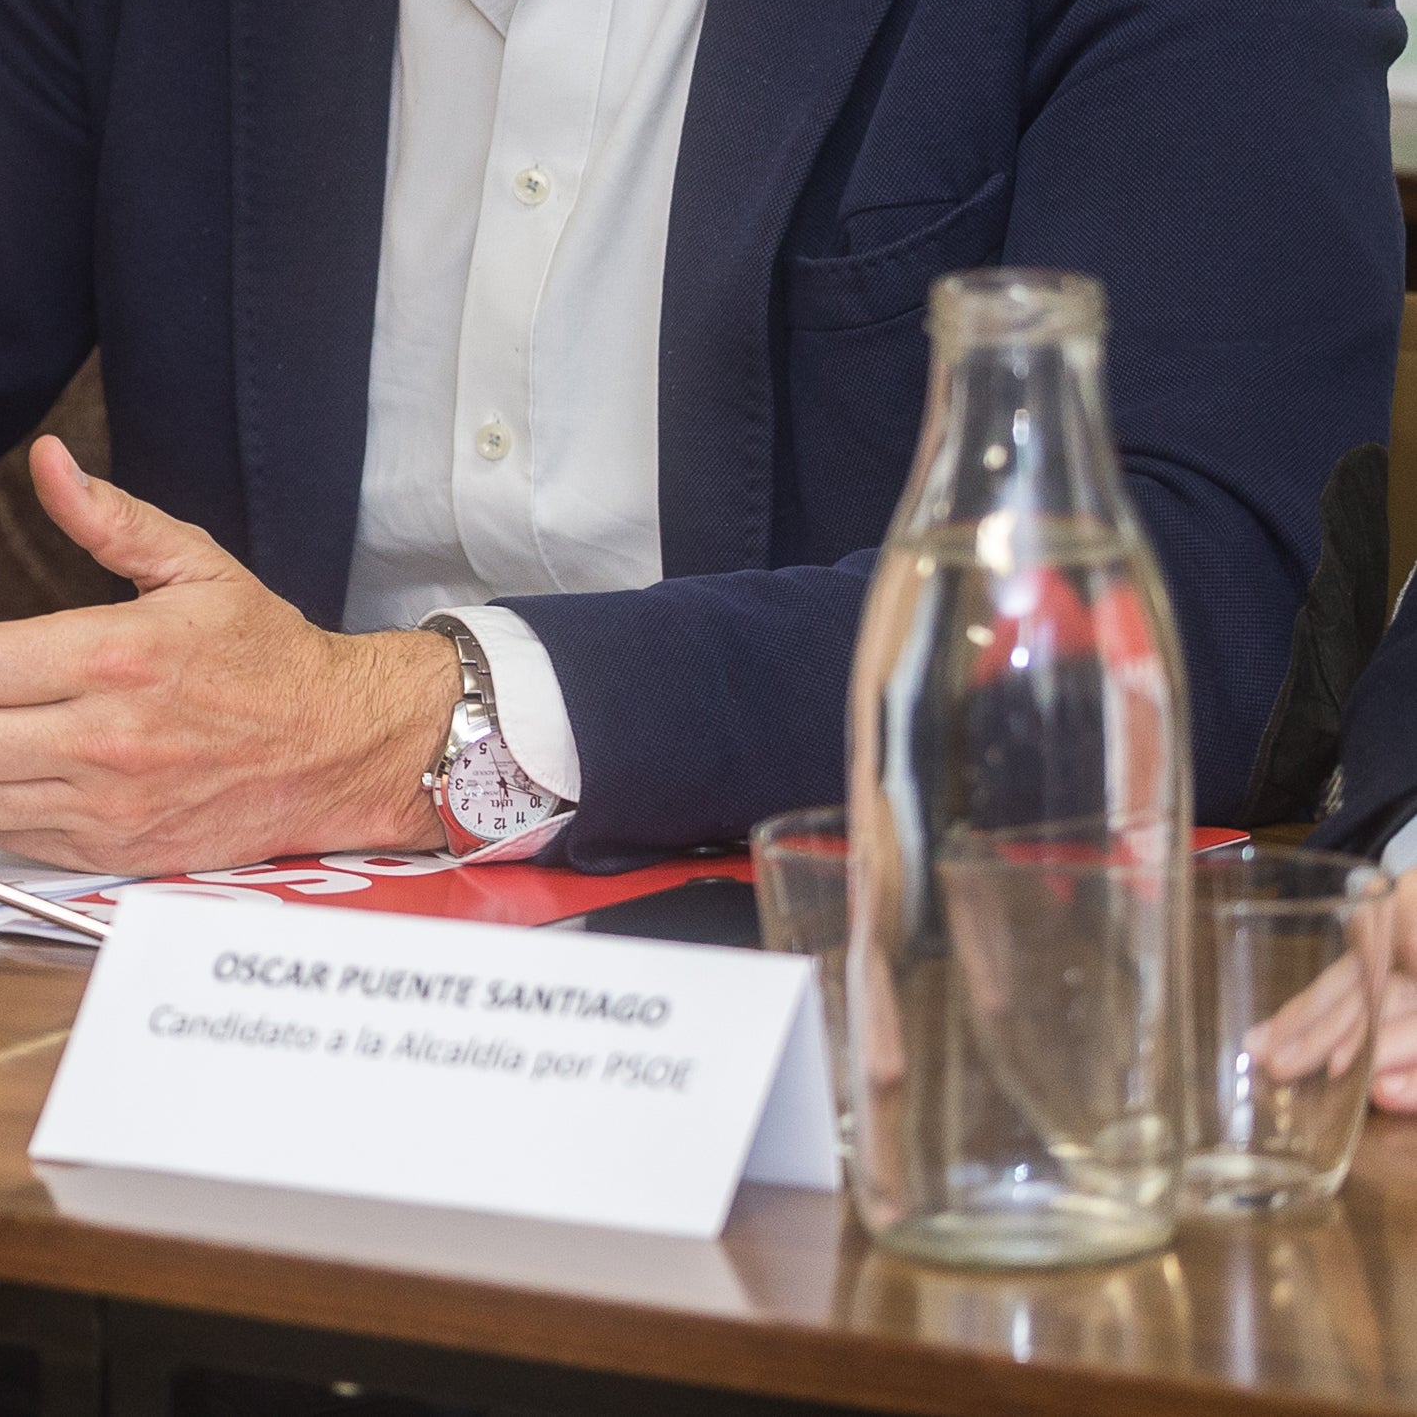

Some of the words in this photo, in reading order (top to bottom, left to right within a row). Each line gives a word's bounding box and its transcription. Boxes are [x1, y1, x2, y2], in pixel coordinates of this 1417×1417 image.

[479, 742, 487, 755] 5
[463, 758, 472, 770] 4
[455, 778, 464, 790] 3
[461, 798, 470, 811] 2
[530, 796, 543, 808] 10
[477, 813, 483, 824] 1
[494, 817, 508, 830] 12
[516, 811, 526, 824] 11
[212, 950, 329, 988] OSCAR
[337, 963, 475, 1006] PUENTE
[483, 979, 671, 1027] SANTIAGO
[149, 1003, 316, 1054] Candidato
[324, 1029, 346, 1054] a
[353, 1025, 383, 1057] la
[530, 1050, 594, 1082] por
[600, 1050, 695, 1092] PSOE
